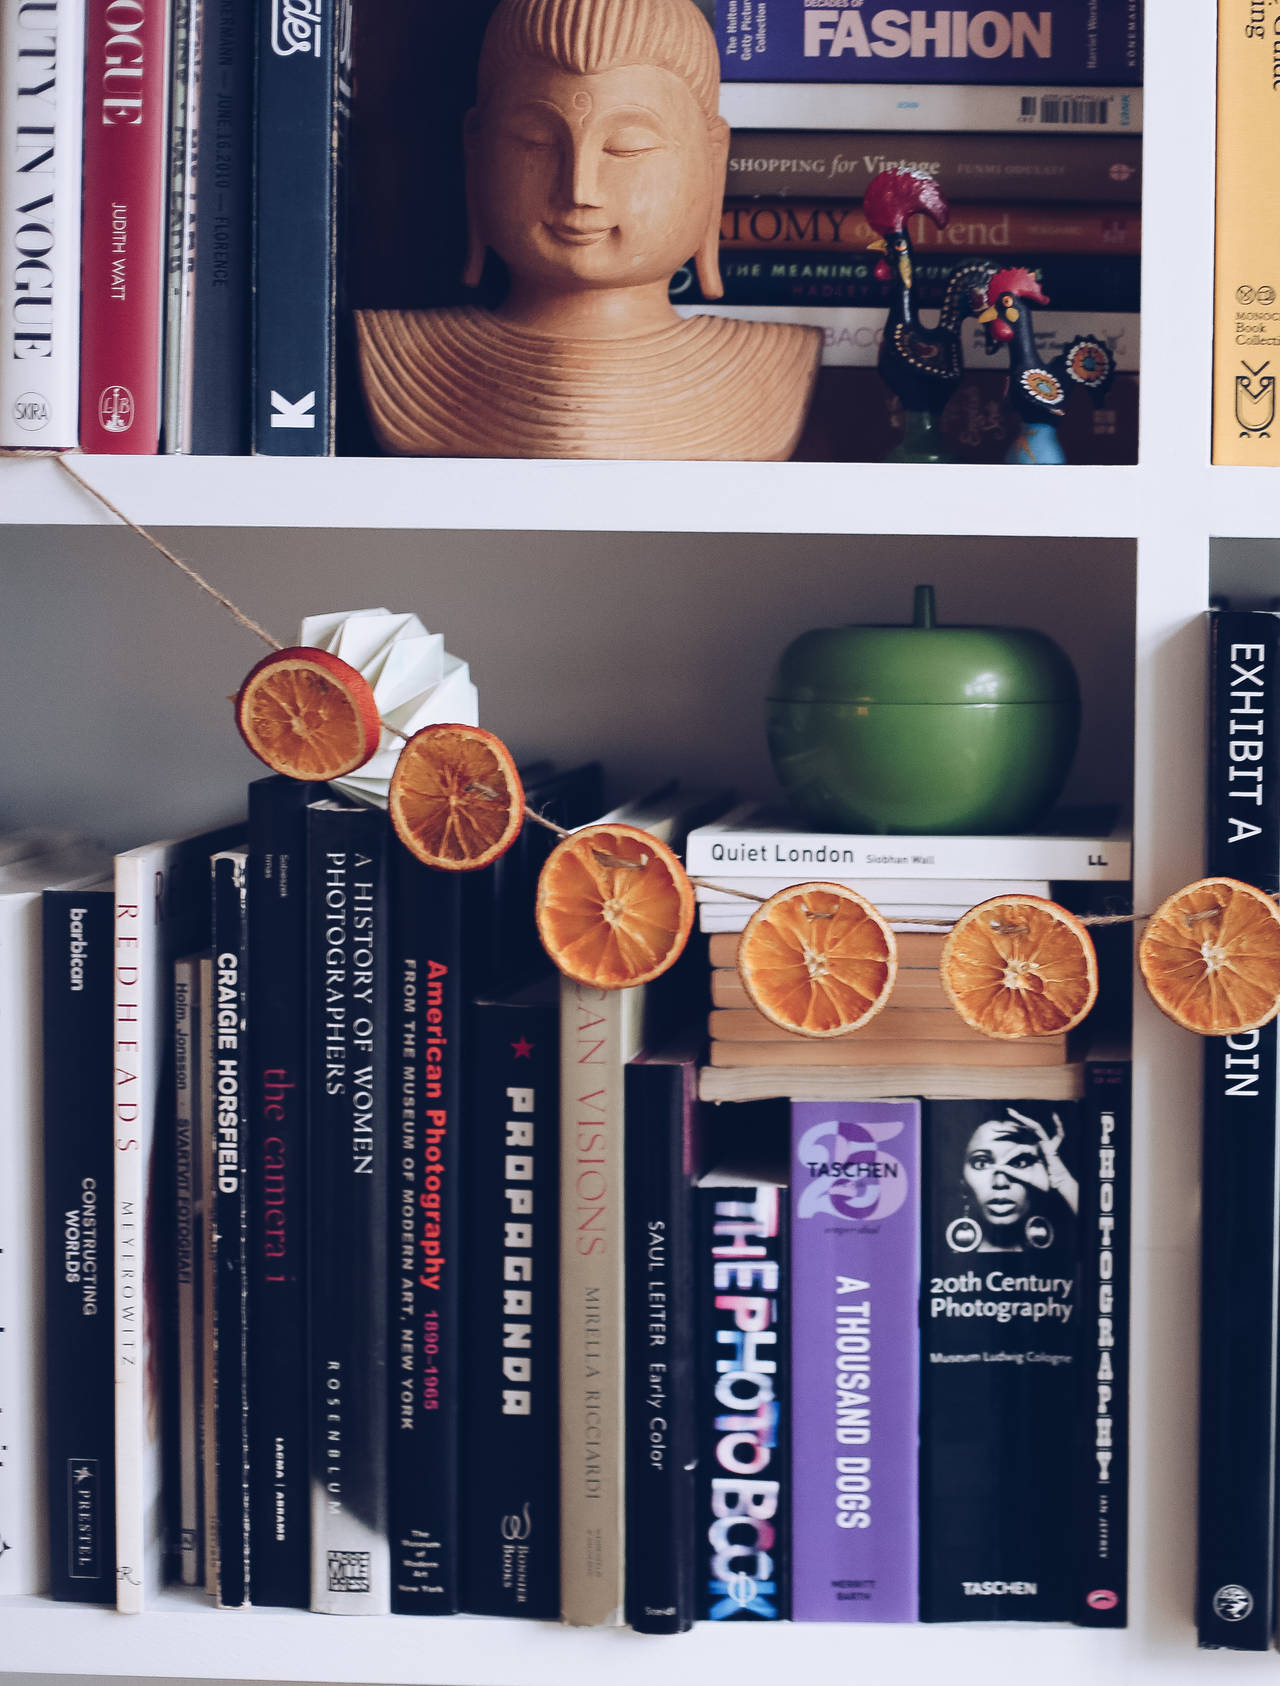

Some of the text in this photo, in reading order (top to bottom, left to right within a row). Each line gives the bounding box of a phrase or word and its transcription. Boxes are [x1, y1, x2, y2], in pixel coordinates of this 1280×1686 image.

[102, 0, 145, 125] OGUE
[727, 37, 737, 56] The
[741, 36, 752, 62] Getty
[757, 3, 767, 53] Collection
[803, 10, 1052, 59] FASHION
[729, 154, 858, 180] SHOPPING for
[12, 125, 56, 360] IN VOGUE
[110, 202, 128, 300] JUDITH WATT
[211, 215, 232, 288] FLORENCE
[727, 264, 868, 279] THE MEANING
[1235, 322, 1267, 333] Book
[270, 390, 316, 428] K
[1227, 641, 1265, 844] EXHIBIT A
[711, 843, 768, 864] Quiet
[775, 845, 855, 865] London
[911, 854, 935, 866] Wall
[69, 908, 88, 992] barbican
[325, 852, 347, 1096] PHOTOGRAPHERS
[352, 852, 374, 1175] A HISTORY OF WOMEN
[176, 1028, 190, 1090] Jonsson
[217, 952, 239, 1194] CRAIGIE HORSFIELD
[114, 903, 140, 1367] REDHEADS MEYEROWITZ
[263, 1068, 296, 1258] the camera
[808, 1161, 898, 1178] TASCHEN
[400, 959, 417, 1431] FROM THE MUSEUM OF MODERN ART, NEW YORK
[418, 959, 448, 1411] American Photography 1890-1965
[64, 1209, 81, 1284] WORLDS
[81, 1177, 97, 1316] CONSTRUCTING
[501, 1087, 536, 1416] PROPAGANDA
[713, 1187, 779, 1291] THE
[575, 1089, 608, 1500] VISIONS MIRELLA RICCIARDI
[836, 1275, 870, 1294] A
[930, 1271, 1073, 1298] 20th Century
[930, 1297, 1073, 1323] Photography
[1096, 1112, 1116, 1484] PHOTOGRAPHY
[648, 1220, 668, 1472] SAUL LEITER Early Color
[714, 1295, 780, 1475] PHOTO
[835, 1301, 871, 1446] THOUSAND
[930, 1352, 1073, 1367] Museum Ludwig Cologne
[326, 1361, 341, 1516] ROSENBLUM
[77, 1489, 92, 1567] PRESTEL
[835, 1457, 871, 1530] DOGS
[961, 1581, 1037, 1596] TASCHEN
